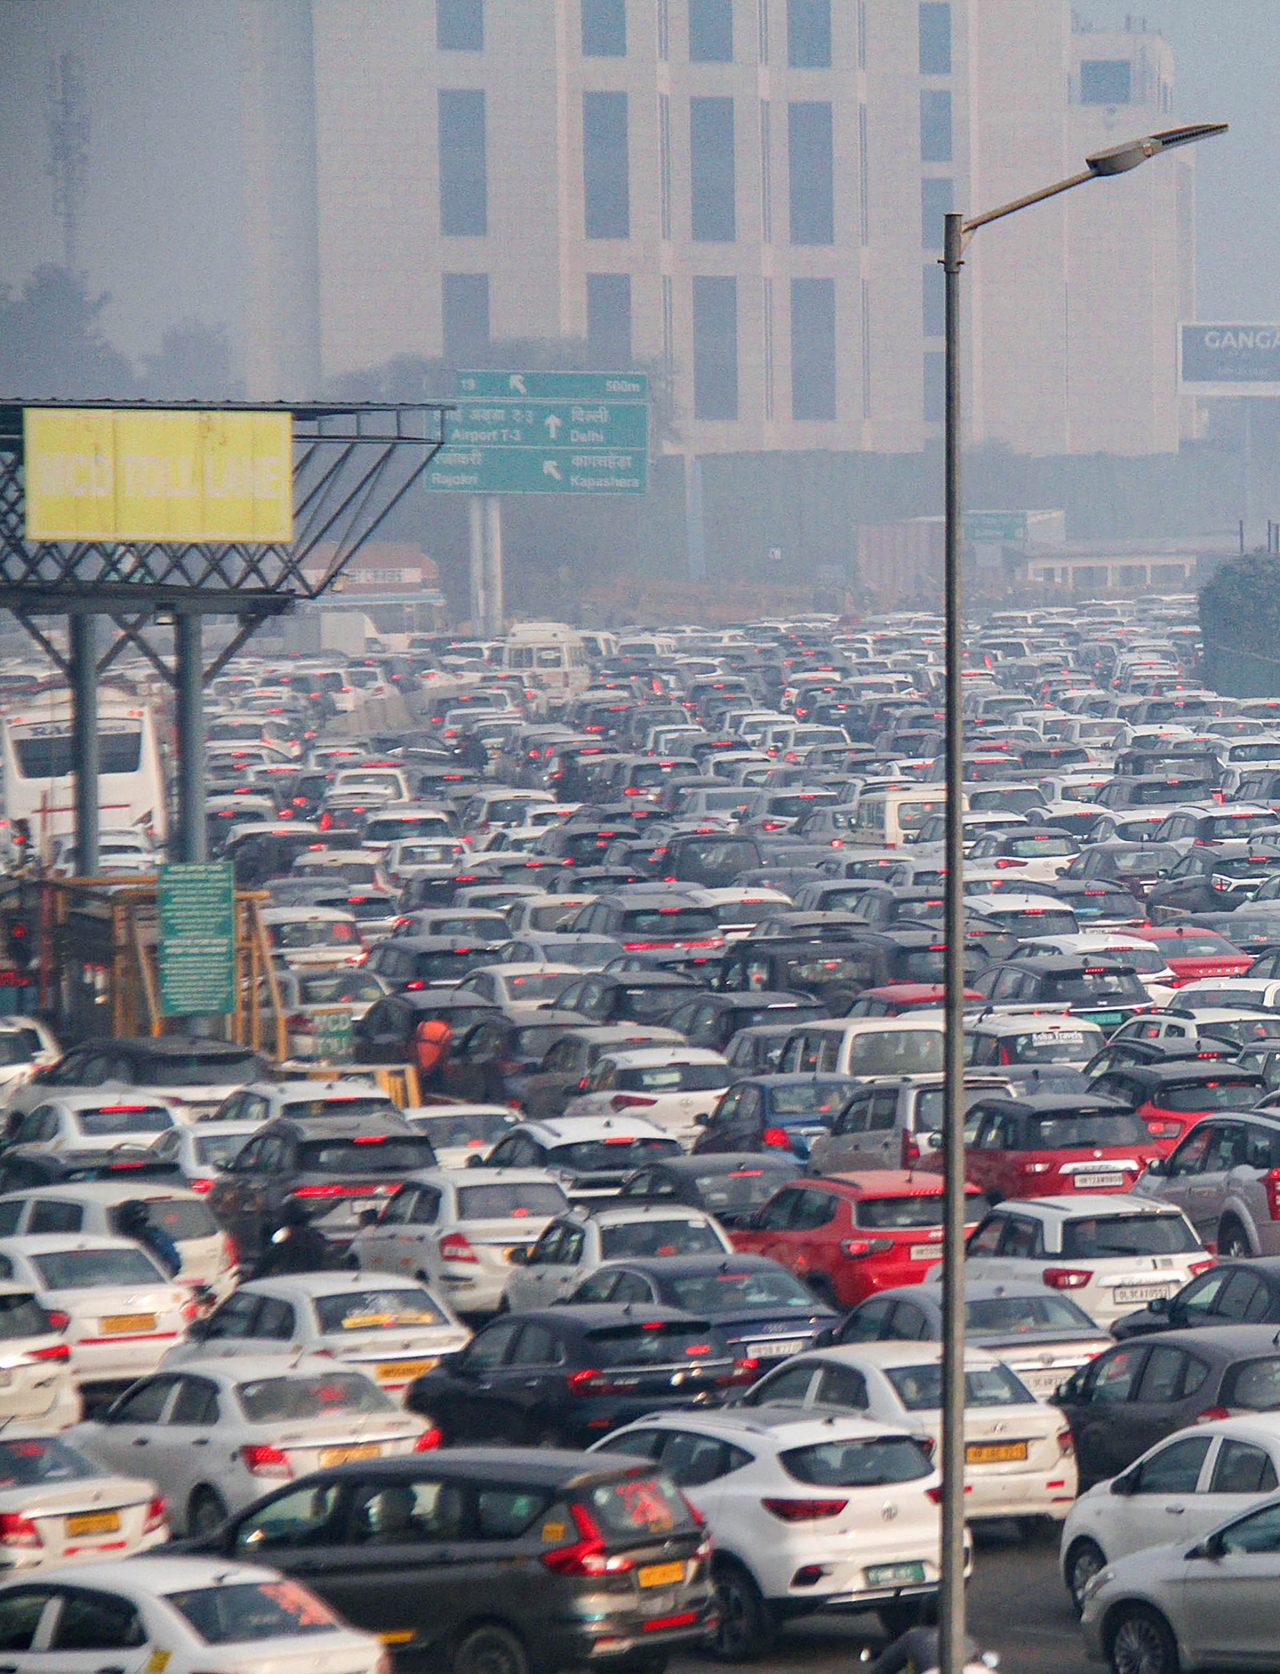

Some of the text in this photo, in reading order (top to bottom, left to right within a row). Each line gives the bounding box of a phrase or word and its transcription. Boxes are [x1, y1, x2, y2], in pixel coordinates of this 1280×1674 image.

[452, 429, 497, 443] Airport
[570, 429, 604, 443] Delhi
[122, 455, 200, 497] TOLL
